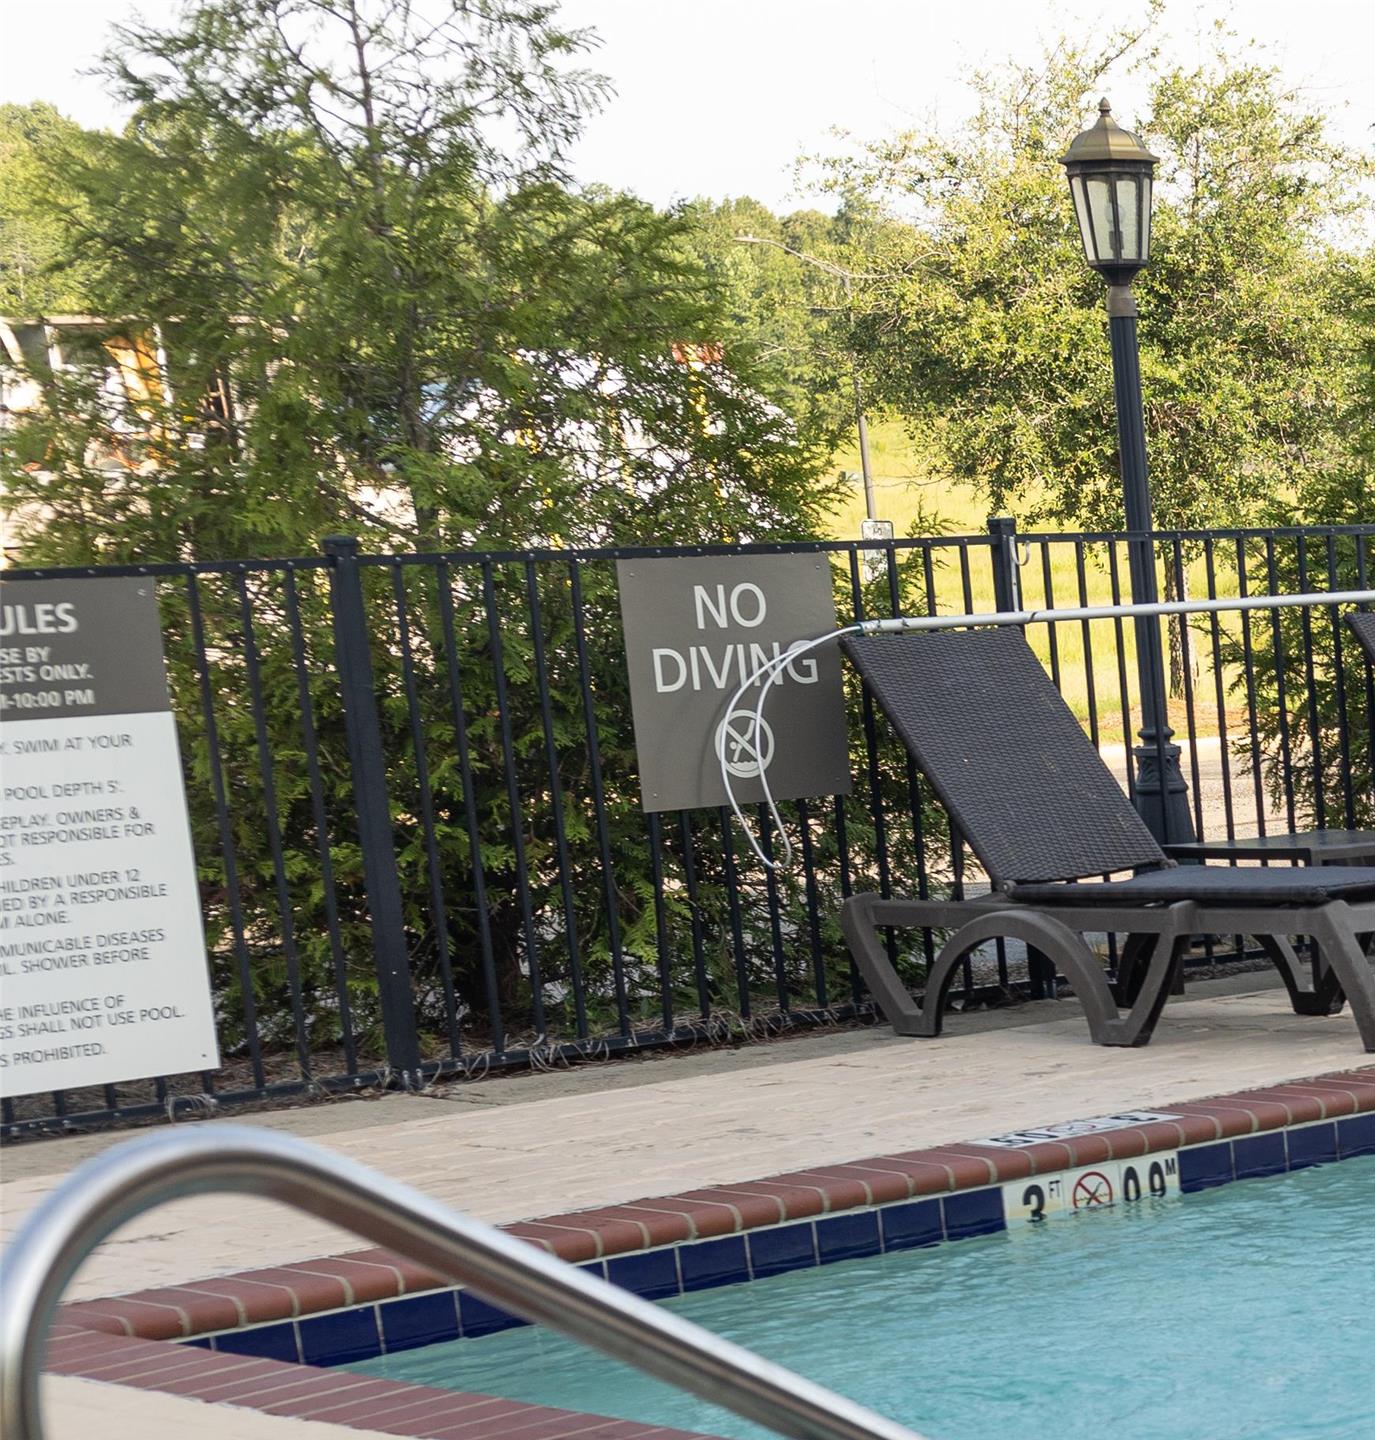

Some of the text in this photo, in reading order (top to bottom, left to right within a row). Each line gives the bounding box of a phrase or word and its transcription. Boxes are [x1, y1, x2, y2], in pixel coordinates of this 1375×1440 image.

[693, 583, 767, 629] NO
[25, 646, 50, 663] BY
[40, 663, 95, 681] ONLY.
[652, 640, 819, 693] DIVING
[64, 689, 95, 705] PM
[14, 739, 58, 754] SWIM
[64, 736, 83, 750] AT
[87, 734, 132, 748] YOUR
[4, 786, 49, 800] POOL
[52, 782, 103, 797] DEPTH
[56, 807, 124, 825] OWNERS
[129, 806, 141, 820] &
[21, 825, 120, 846] RESPONSIBLE
[124, 823, 156, 838] FOR
[66, 870, 120, 888] UNDER
[125, 868, 141, 882] 12
[28, 894, 48, 909] BY
[54, 893, 66, 907] A
[70, 883, 168, 904] RESPONSIBLE
[15, 910, 70, 928] ALONE.
[96, 928, 165, 948] DISEASES
[21, 953, 88, 974] SHOWER
[93, 947, 151, 966] BEFORE
[18, 998, 99, 1020] INFLUENCE
[104, 994, 125, 1009] OF
[17, 1018, 66, 1038] SHALL
[70, 1014, 103, 1031] NOT
[107, 1010, 135, 1026] USE
[140, 1006, 186, 1022] POOL.
[13, 1042, 107, 1066] PROHIBITED.
